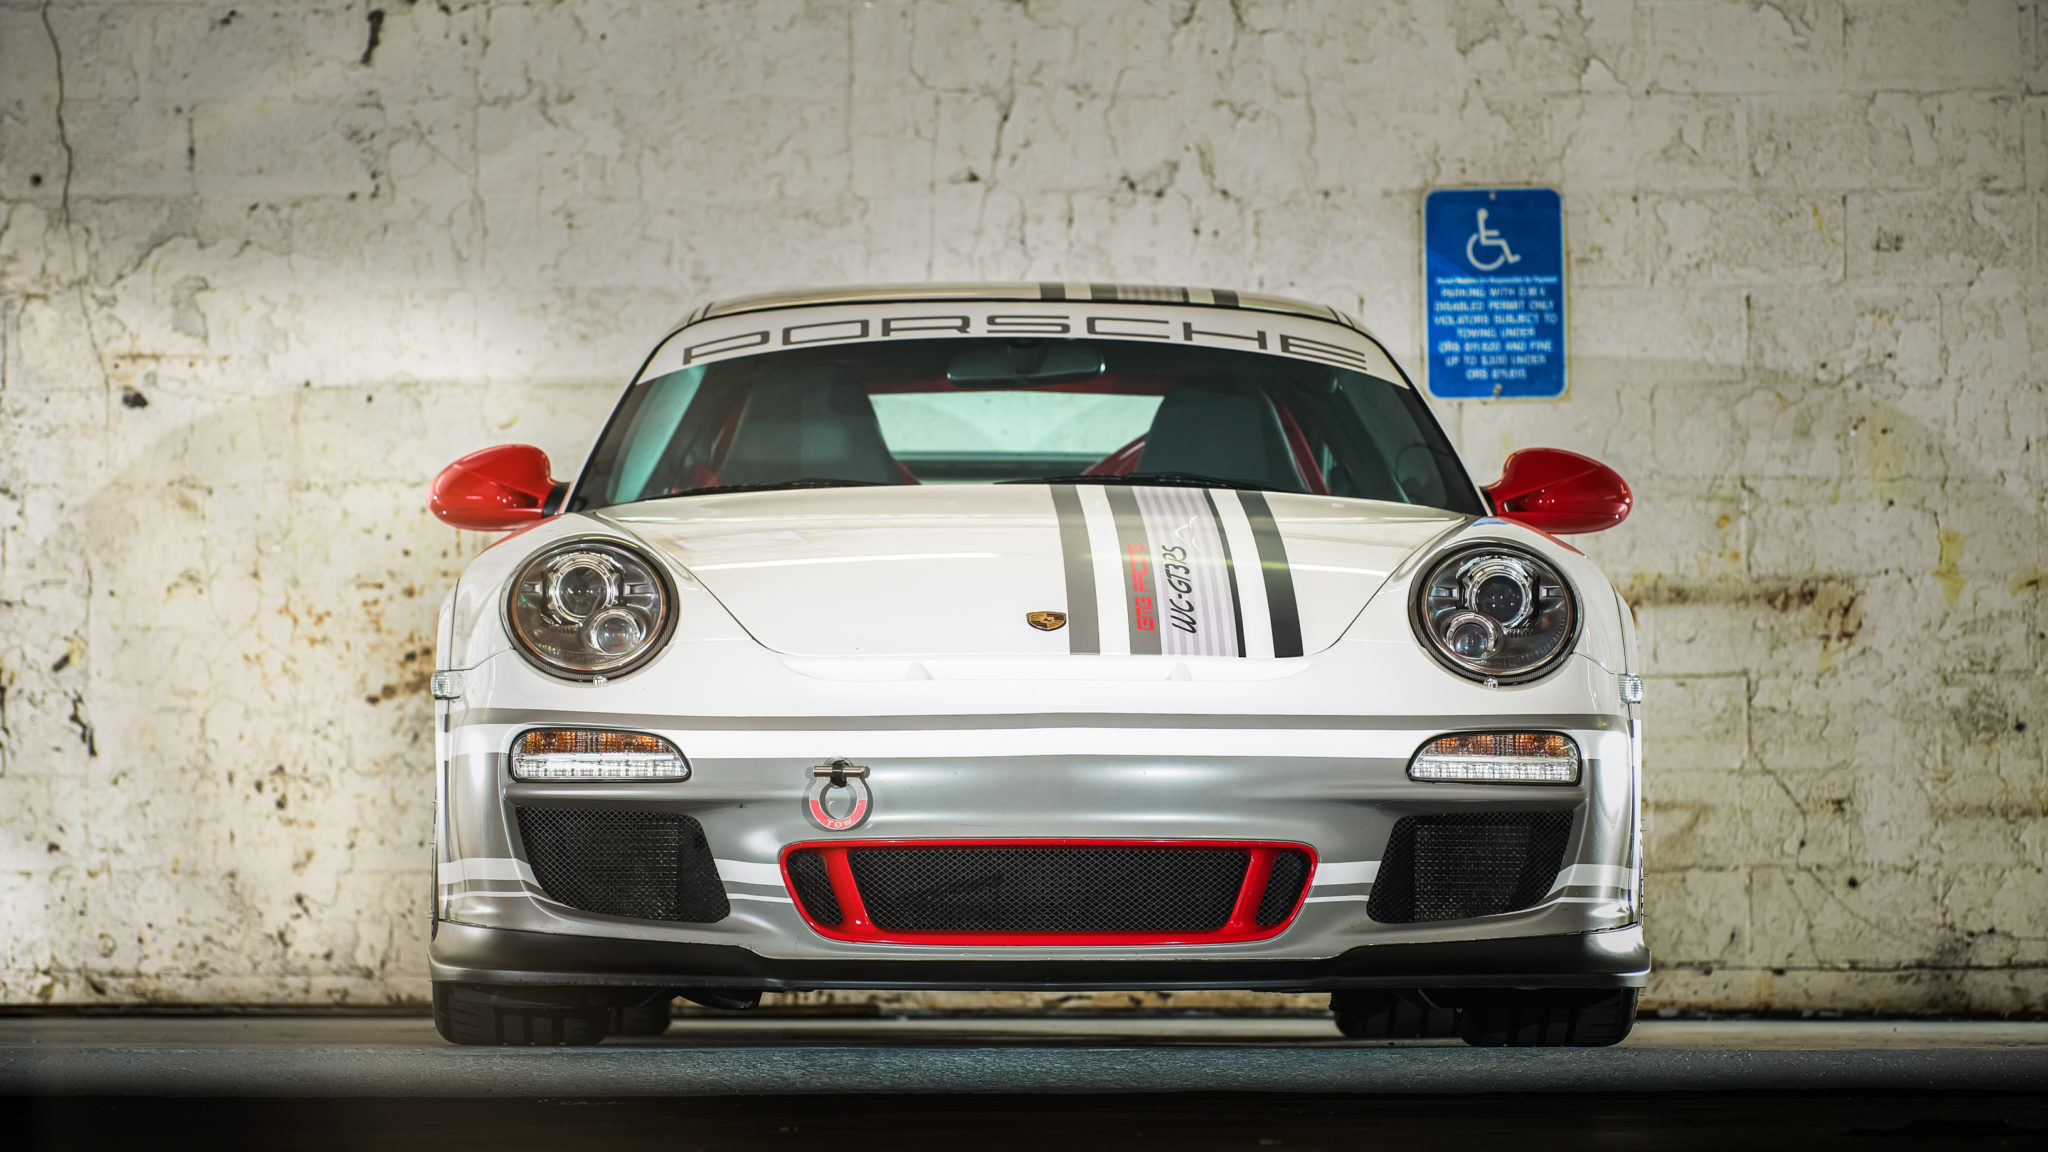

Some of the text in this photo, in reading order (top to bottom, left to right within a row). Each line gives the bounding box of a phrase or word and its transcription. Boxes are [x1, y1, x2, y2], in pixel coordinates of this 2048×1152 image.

[1489, 287, 1516, 297] WITH
[1435, 300, 1554, 311] DISABLED PERMIT ONLY
[1434, 313, 1557, 325] VIOLATORS SUBJECT TO
[1457, 328, 1535, 338] TOWING UNDER
[683, 315, 1367, 371] PORSCHE
[1505, 342, 1526, 352] AND
[1529, 341, 1552, 352] FINE
[1445, 355, 1459, 366] UP
[1463, 355, 1477, 366] TO
[1511, 355, 1546, 365] UNDER
[1162, 545, 1197, 634] WC-GT3RS
[1135, 596, 1155, 631] GMG
[827, 819, 852, 829] TOW
